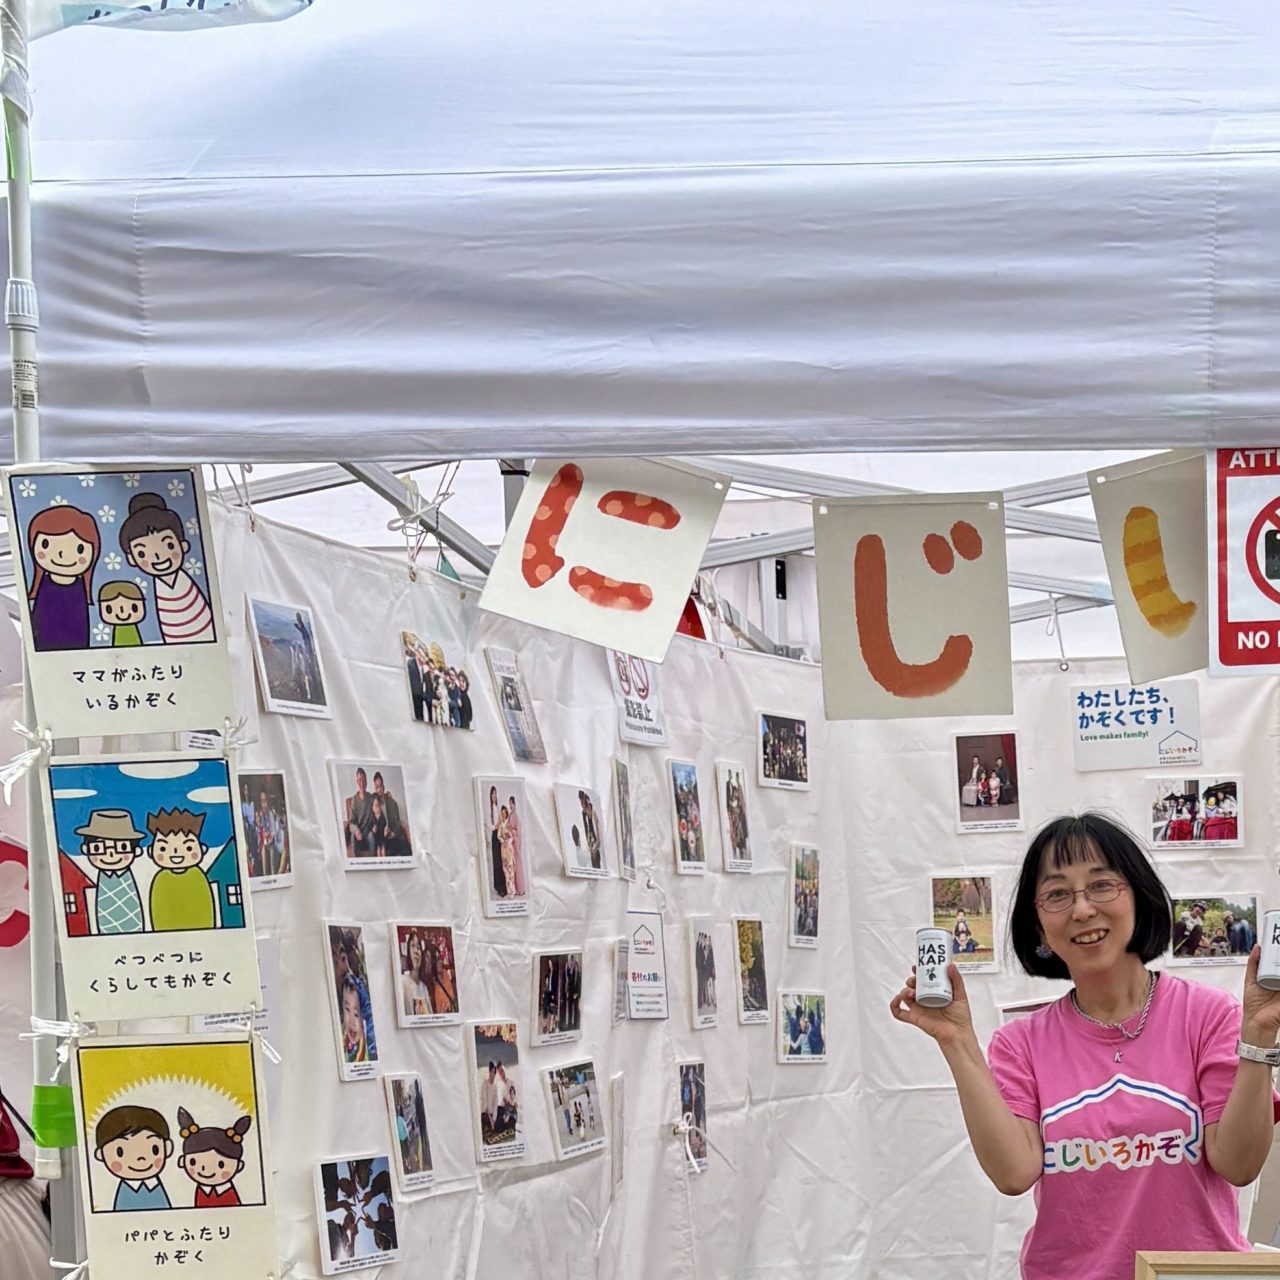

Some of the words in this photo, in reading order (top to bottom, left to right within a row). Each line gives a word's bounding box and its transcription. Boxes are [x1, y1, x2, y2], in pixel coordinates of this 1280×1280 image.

[521, 462, 682, 612] に
[854, 520, 983, 699] じ
[72, 664, 184, 684] ママがふたり
[86, 692, 178, 711] いるかぞく
[1077, 687, 1168, 709] わたしたち、
[1078, 707, 1175, 729] かぞくです！
[1080, 734, 1097, 742] Love
[1099, 732, 1122, 741] makes
[1123, 730, 1149, 740] family!
[114, 951, 203, 966] べつべつに
[918, 944, 946, 956] HAS
[918, 954, 946, 966] KAP
[90, 971, 233, 993] くらしてもかぞく
[125, 1226, 231, 1243] パパとふたり
[155, 1250, 204, 1266] かぞく
